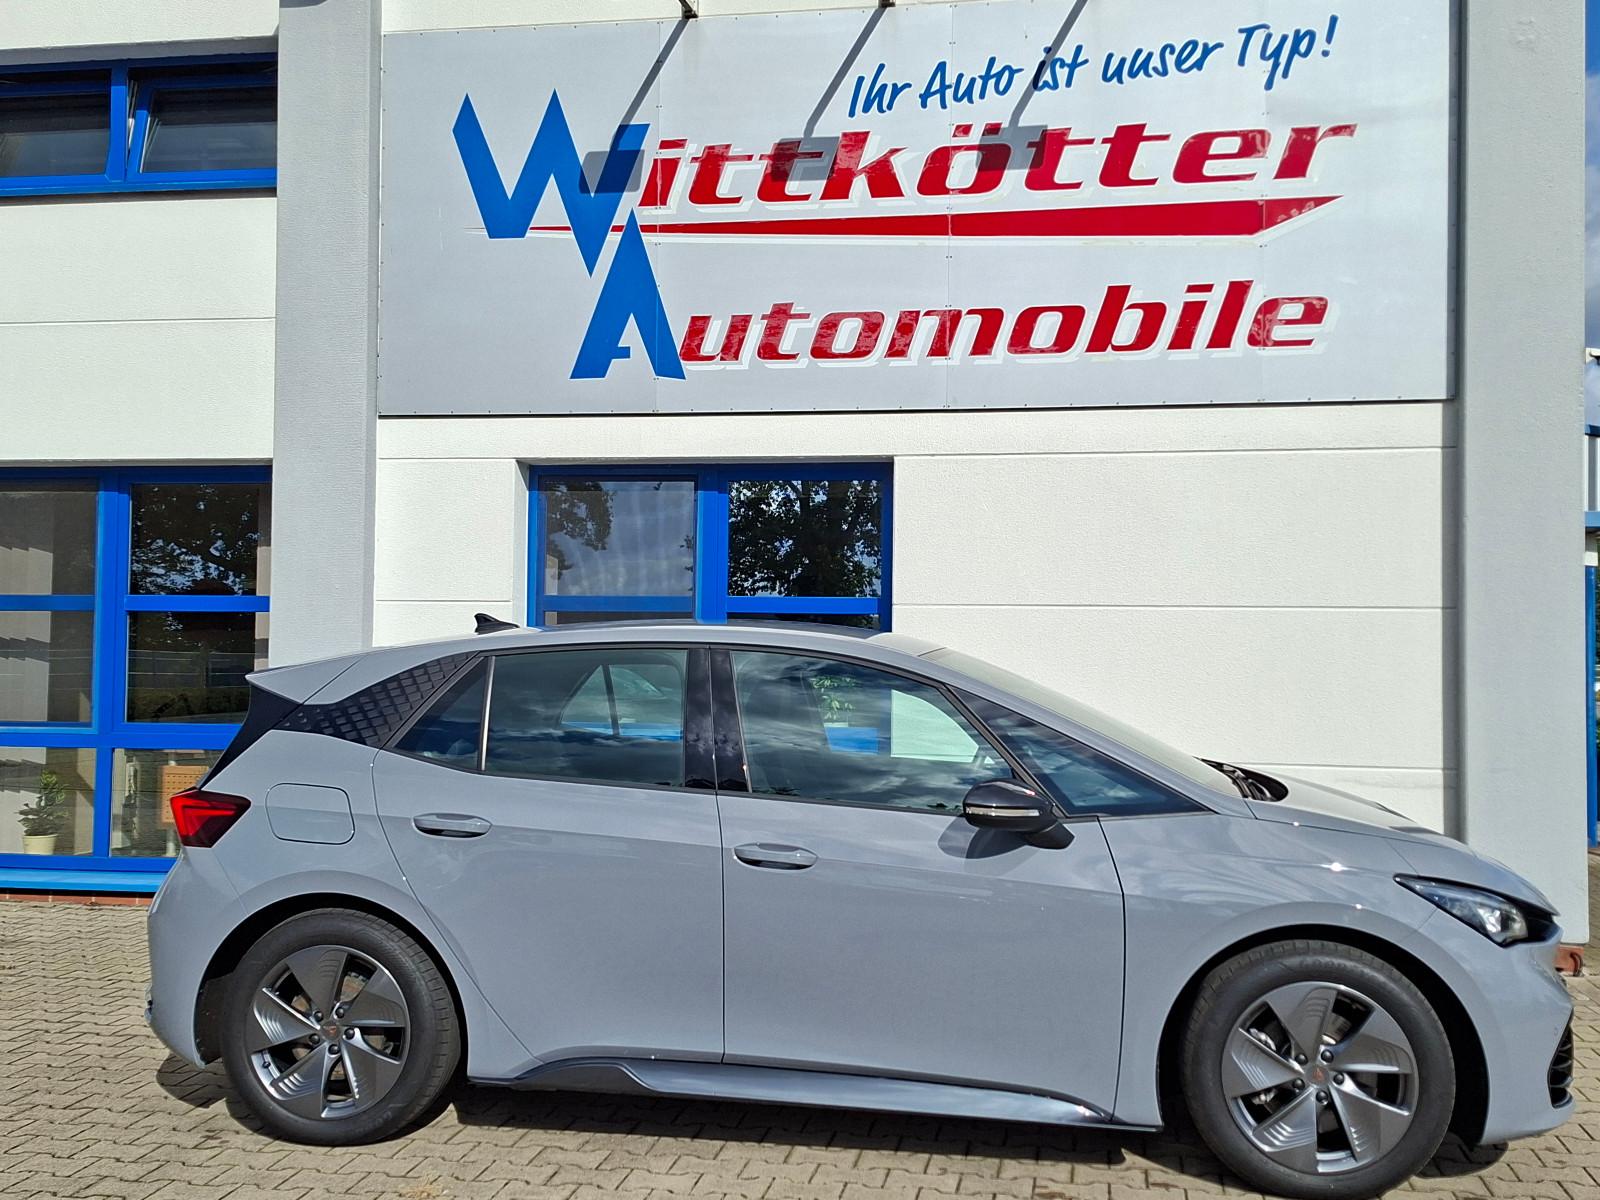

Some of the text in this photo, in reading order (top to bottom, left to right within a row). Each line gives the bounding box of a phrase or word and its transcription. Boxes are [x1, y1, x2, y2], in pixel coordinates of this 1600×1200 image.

[847, 14, 1338, 118] Ihr Auto ist unser Typ!
[452, 88, 1358, 278] Wittkötter
[569, 207, 1332, 380] Automobile
